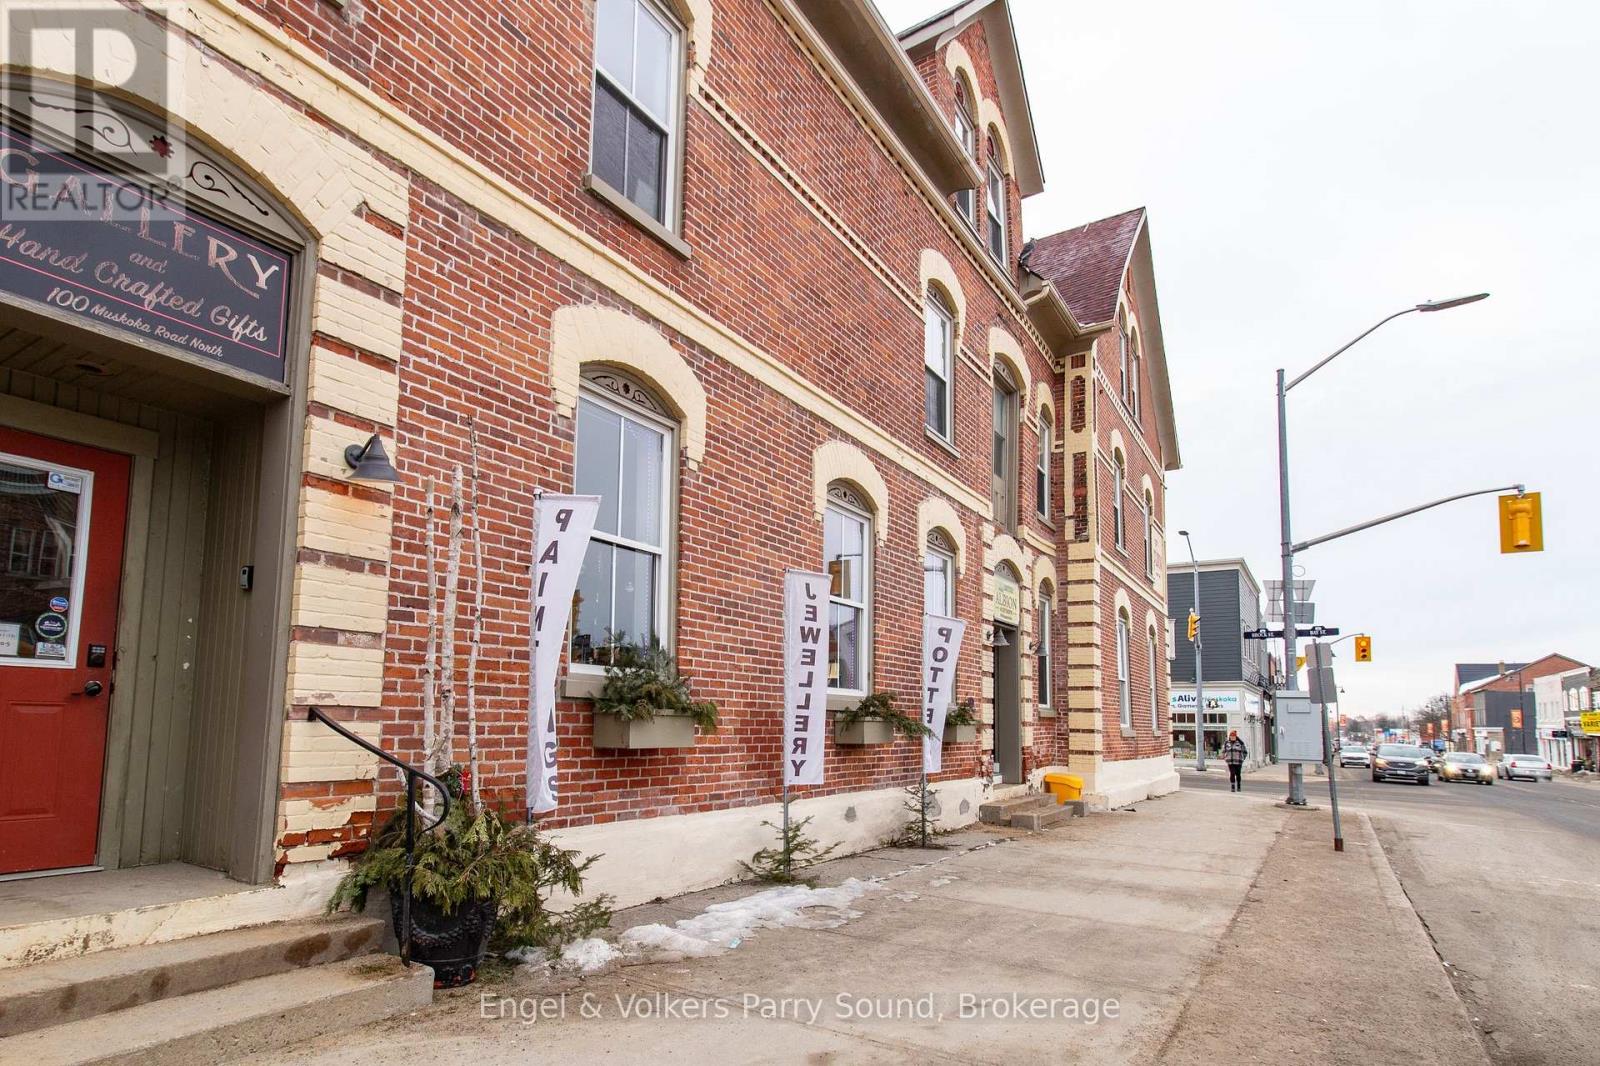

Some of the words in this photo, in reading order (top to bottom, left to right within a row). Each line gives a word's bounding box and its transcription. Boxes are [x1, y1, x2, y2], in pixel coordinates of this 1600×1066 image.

[0, 148, 279, 299] GALLERY
[129, 251, 167, 273] and
[0, 223, 83, 273] Hand
[94, 260, 202, 318] Crafted
[210, 305, 268, 343] Gifts
[47, 287, 89, 312] 100
[91, 304, 151, 333] Muskoka
[154, 325, 187, 346] Road
[189, 337, 223, 358] North
